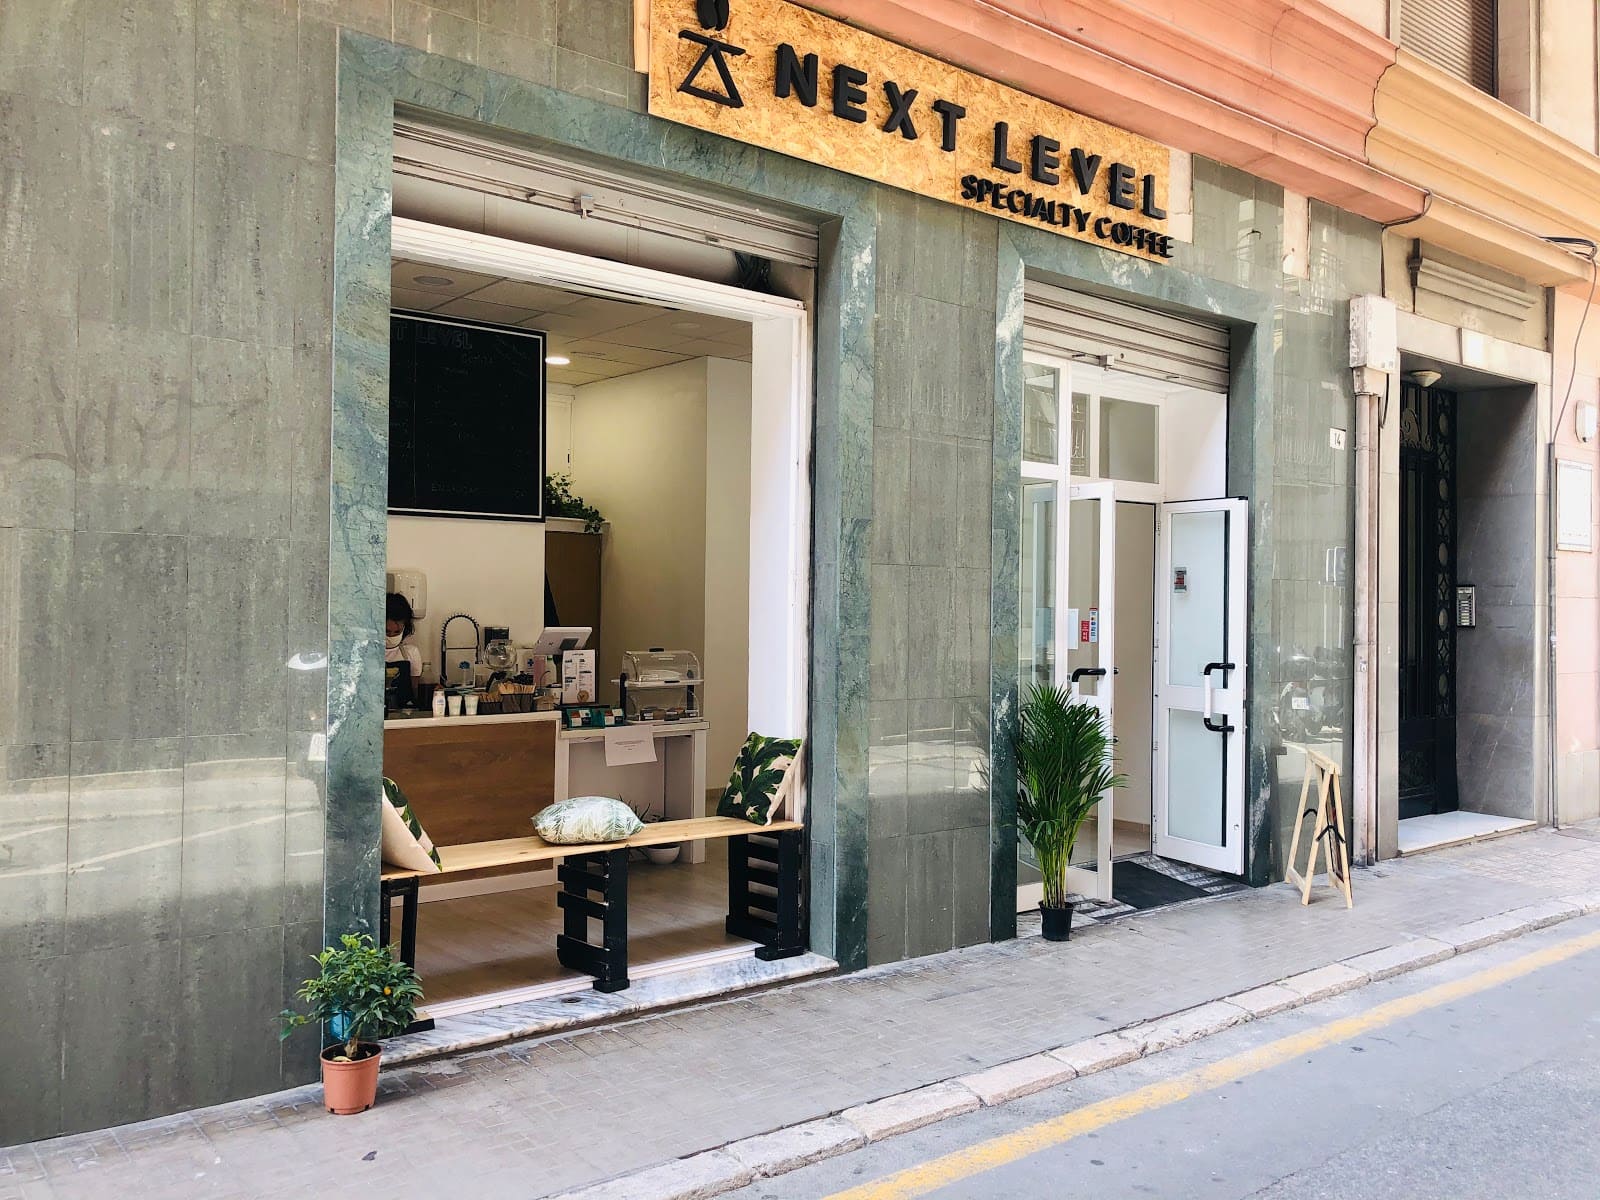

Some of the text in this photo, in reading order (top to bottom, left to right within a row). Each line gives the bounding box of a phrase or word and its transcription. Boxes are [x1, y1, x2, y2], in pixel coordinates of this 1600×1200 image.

[774, 43, 1168, 220] NEXT LEVEL
[960, 174, 1175, 259] SPECIALTY COFFEE
